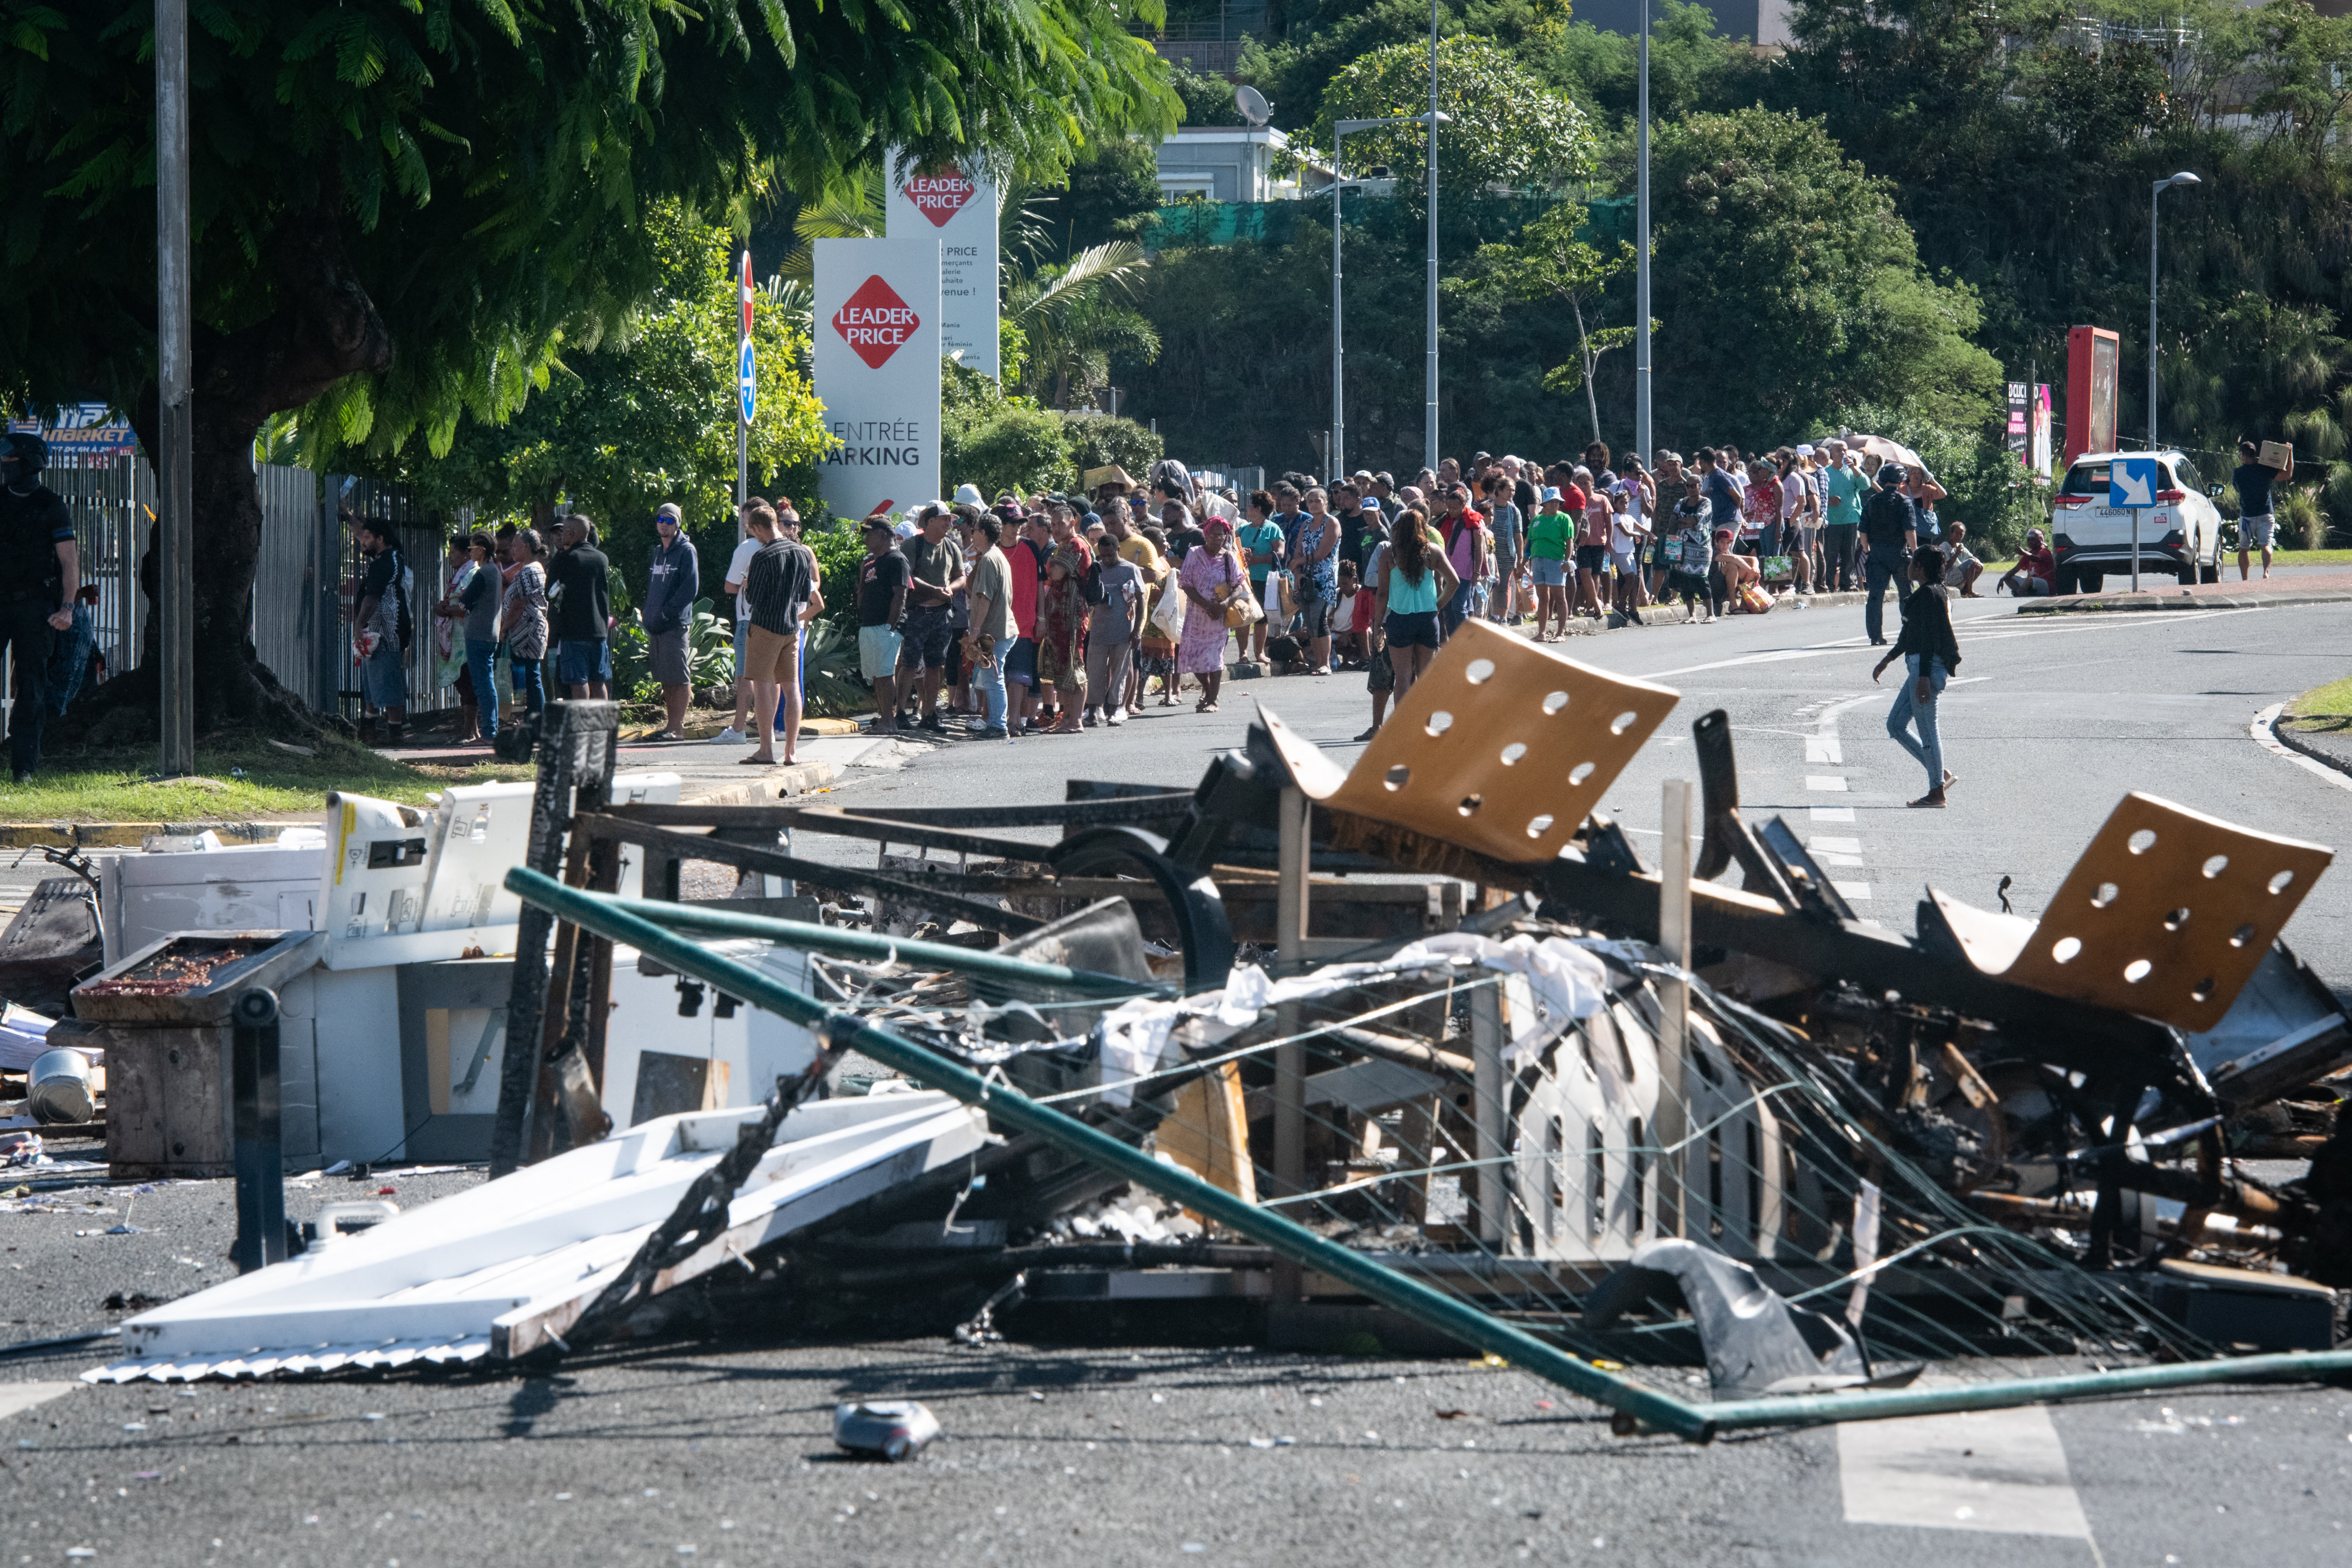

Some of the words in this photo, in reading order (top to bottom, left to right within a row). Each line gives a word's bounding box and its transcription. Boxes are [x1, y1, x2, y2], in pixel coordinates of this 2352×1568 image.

[910, 178, 970, 192] LEADER
[916, 194, 962, 208] PRICE
[947, 247, 977, 256] PRICE
[840, 308, 914, 325] LEADER
[847, 328, 904, 344] PRICE
[834, 418, 919, 441] ENTRÉE
[817, 447, 919, 466] PARKING
